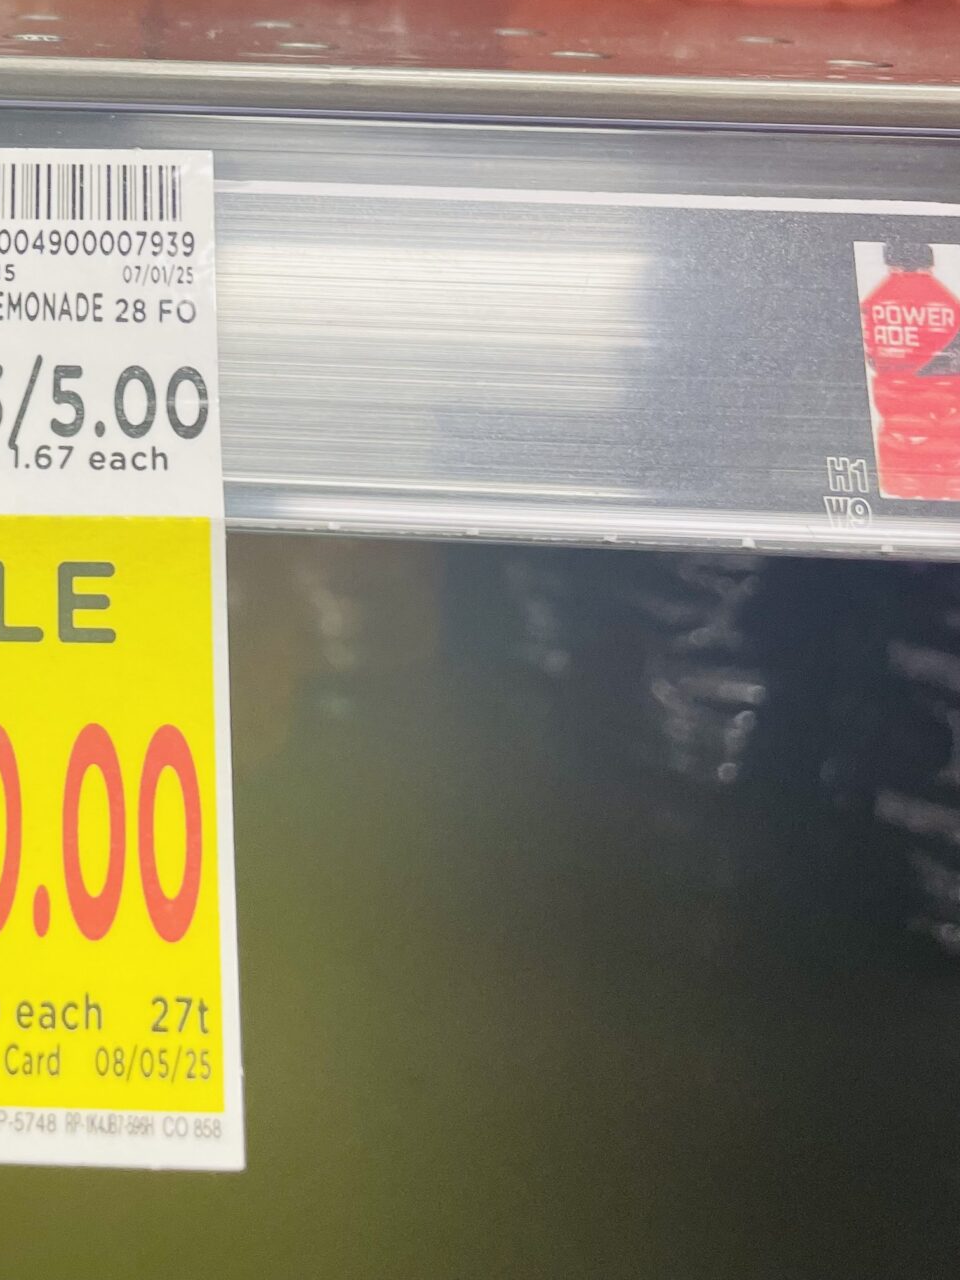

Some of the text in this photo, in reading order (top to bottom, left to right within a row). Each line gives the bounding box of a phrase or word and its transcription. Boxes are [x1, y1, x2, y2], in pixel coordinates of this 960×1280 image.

[123, 264, 194, 287] 07/01/25
[115, 298, 146, 323] 28
[159, 299, 196, 324] FO
[872, 304, 954, 327] POWER
[11, 446, 169, 472] 1.67 each
[16, 992, 103, 1030] each
[151, 996, 209, 1034] 27t
[4, 1042, 61, 1076] Card
[95, 1044, 212, 1084] 08/05/25
